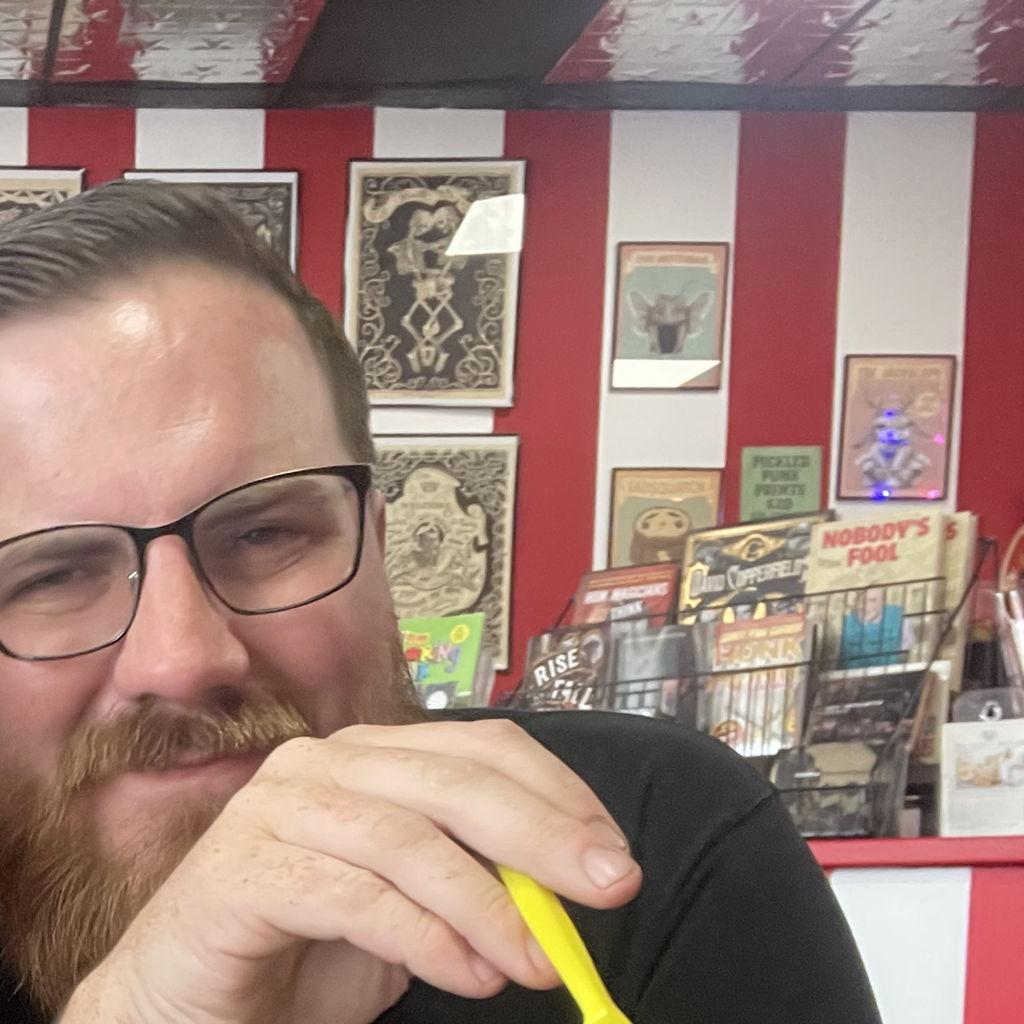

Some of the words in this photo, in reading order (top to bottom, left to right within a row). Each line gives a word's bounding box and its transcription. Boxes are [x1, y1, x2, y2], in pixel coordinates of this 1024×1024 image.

[822, 516, 930, 549] NOBODY'S
[848, 544, 898, 566] FOOL
[534, 648, 580, 687] RISE
